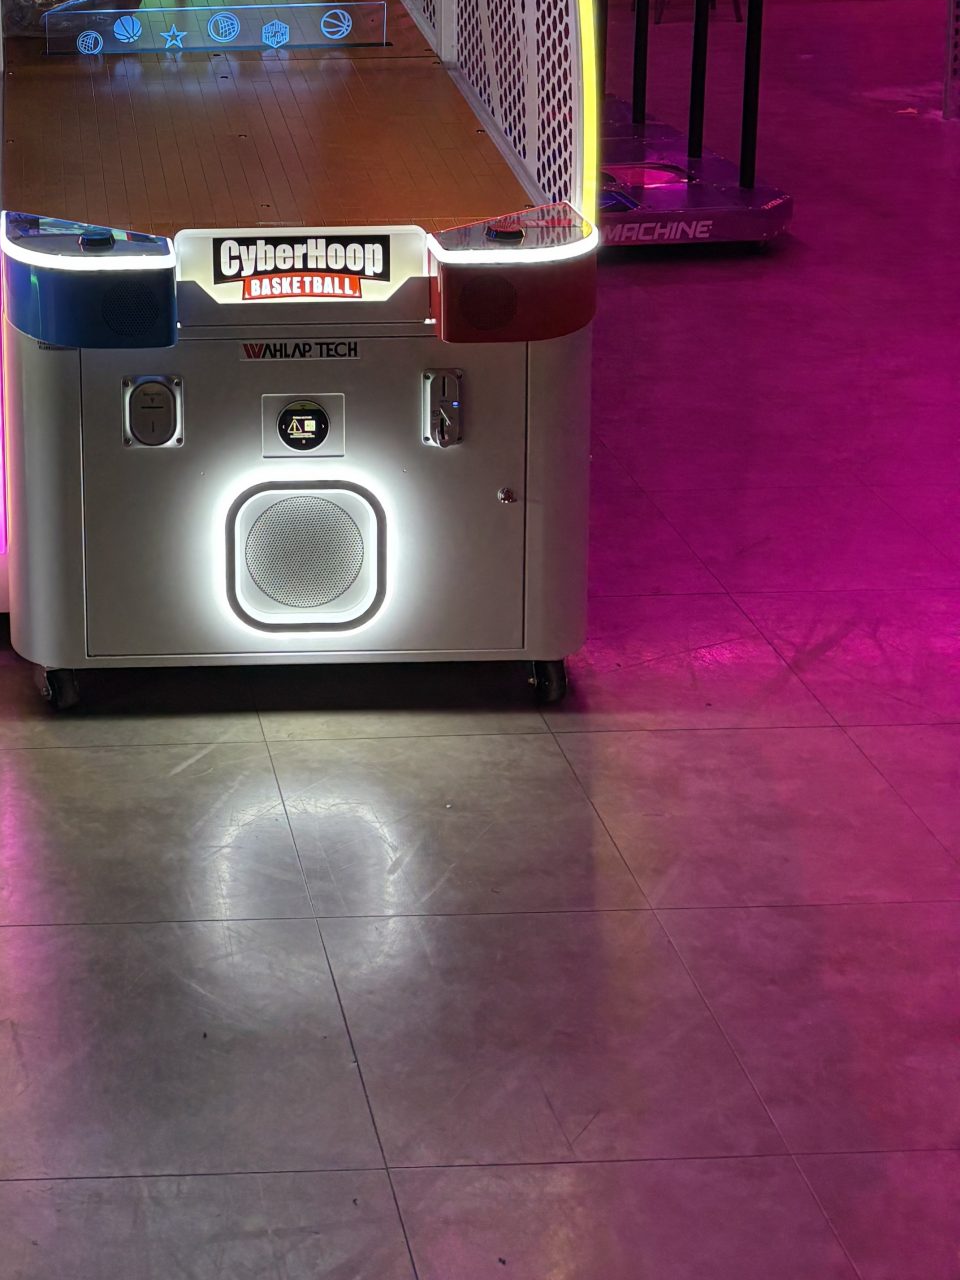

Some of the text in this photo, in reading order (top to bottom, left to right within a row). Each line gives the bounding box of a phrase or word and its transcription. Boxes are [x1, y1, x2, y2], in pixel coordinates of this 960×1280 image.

[604, 220, 713, 242] MACHINE
[220, 237, 385, 278] CyberHoop
[249, 274, 355, 299] BASKETBALL
[316, 341, 359, 359] TECH
